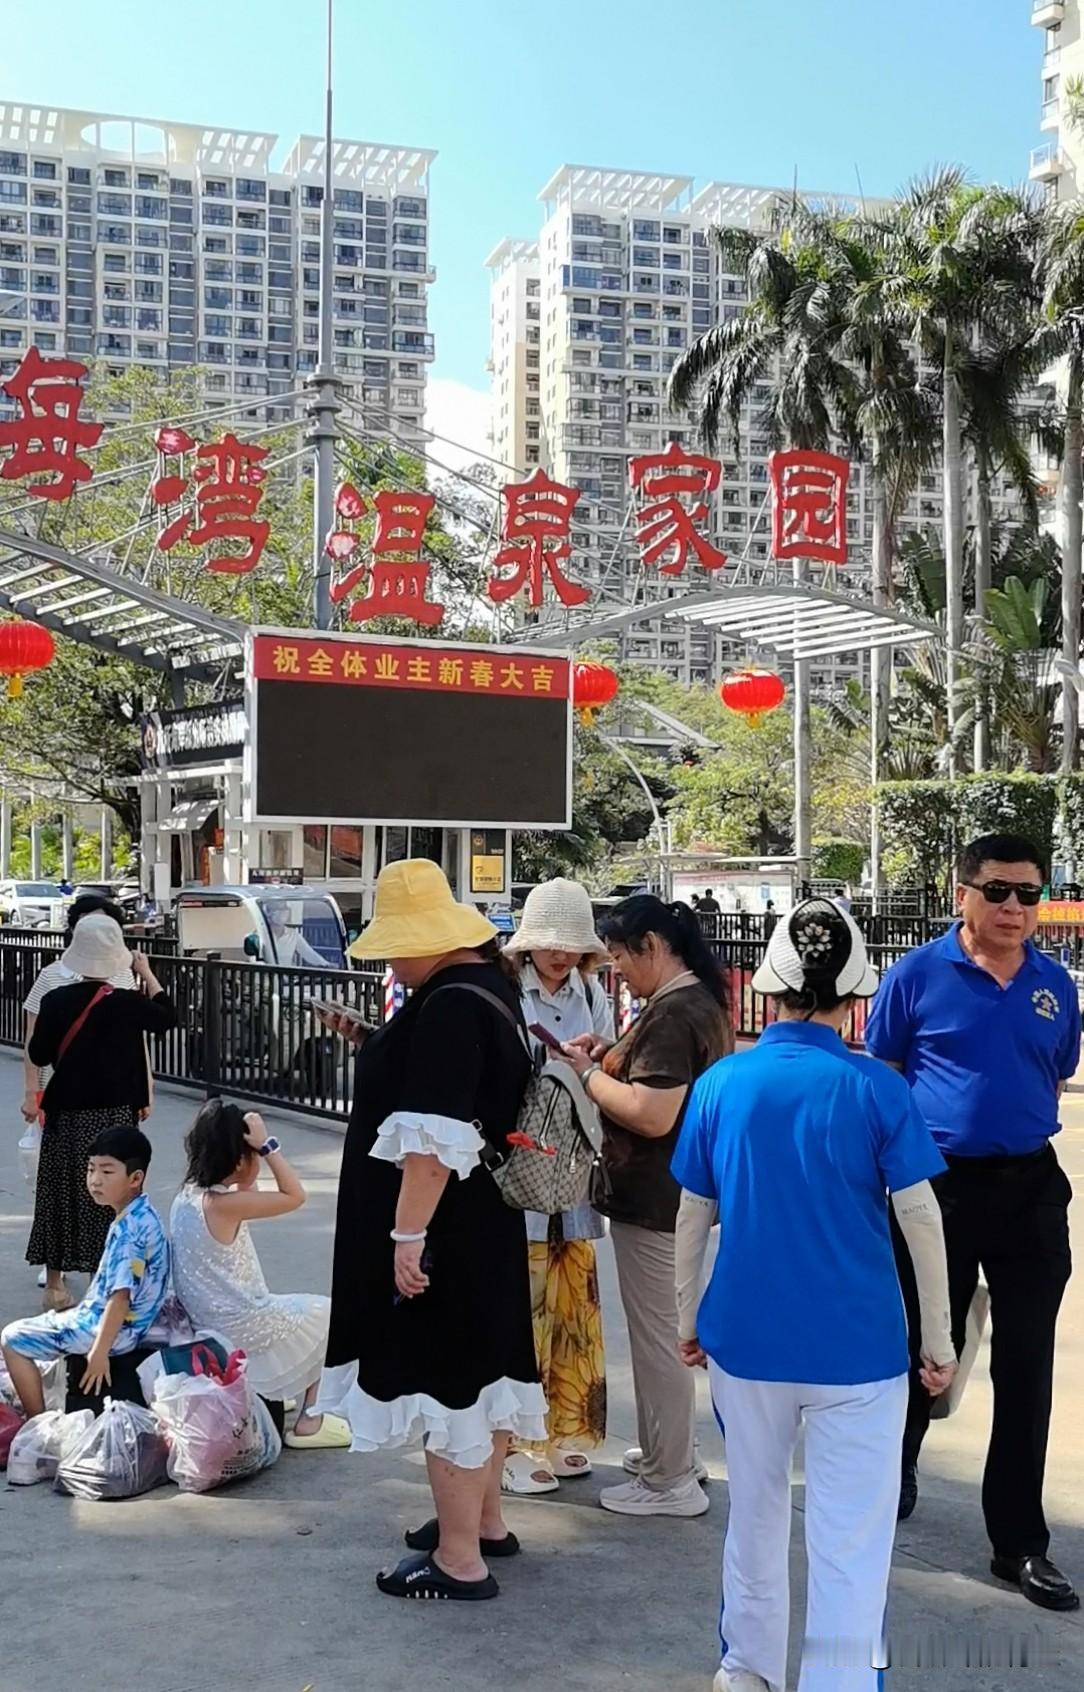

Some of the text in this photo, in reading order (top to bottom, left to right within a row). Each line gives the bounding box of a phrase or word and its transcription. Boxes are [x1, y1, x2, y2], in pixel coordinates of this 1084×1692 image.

[273, 645, 555, 692] 祝全体业主新春大吉
